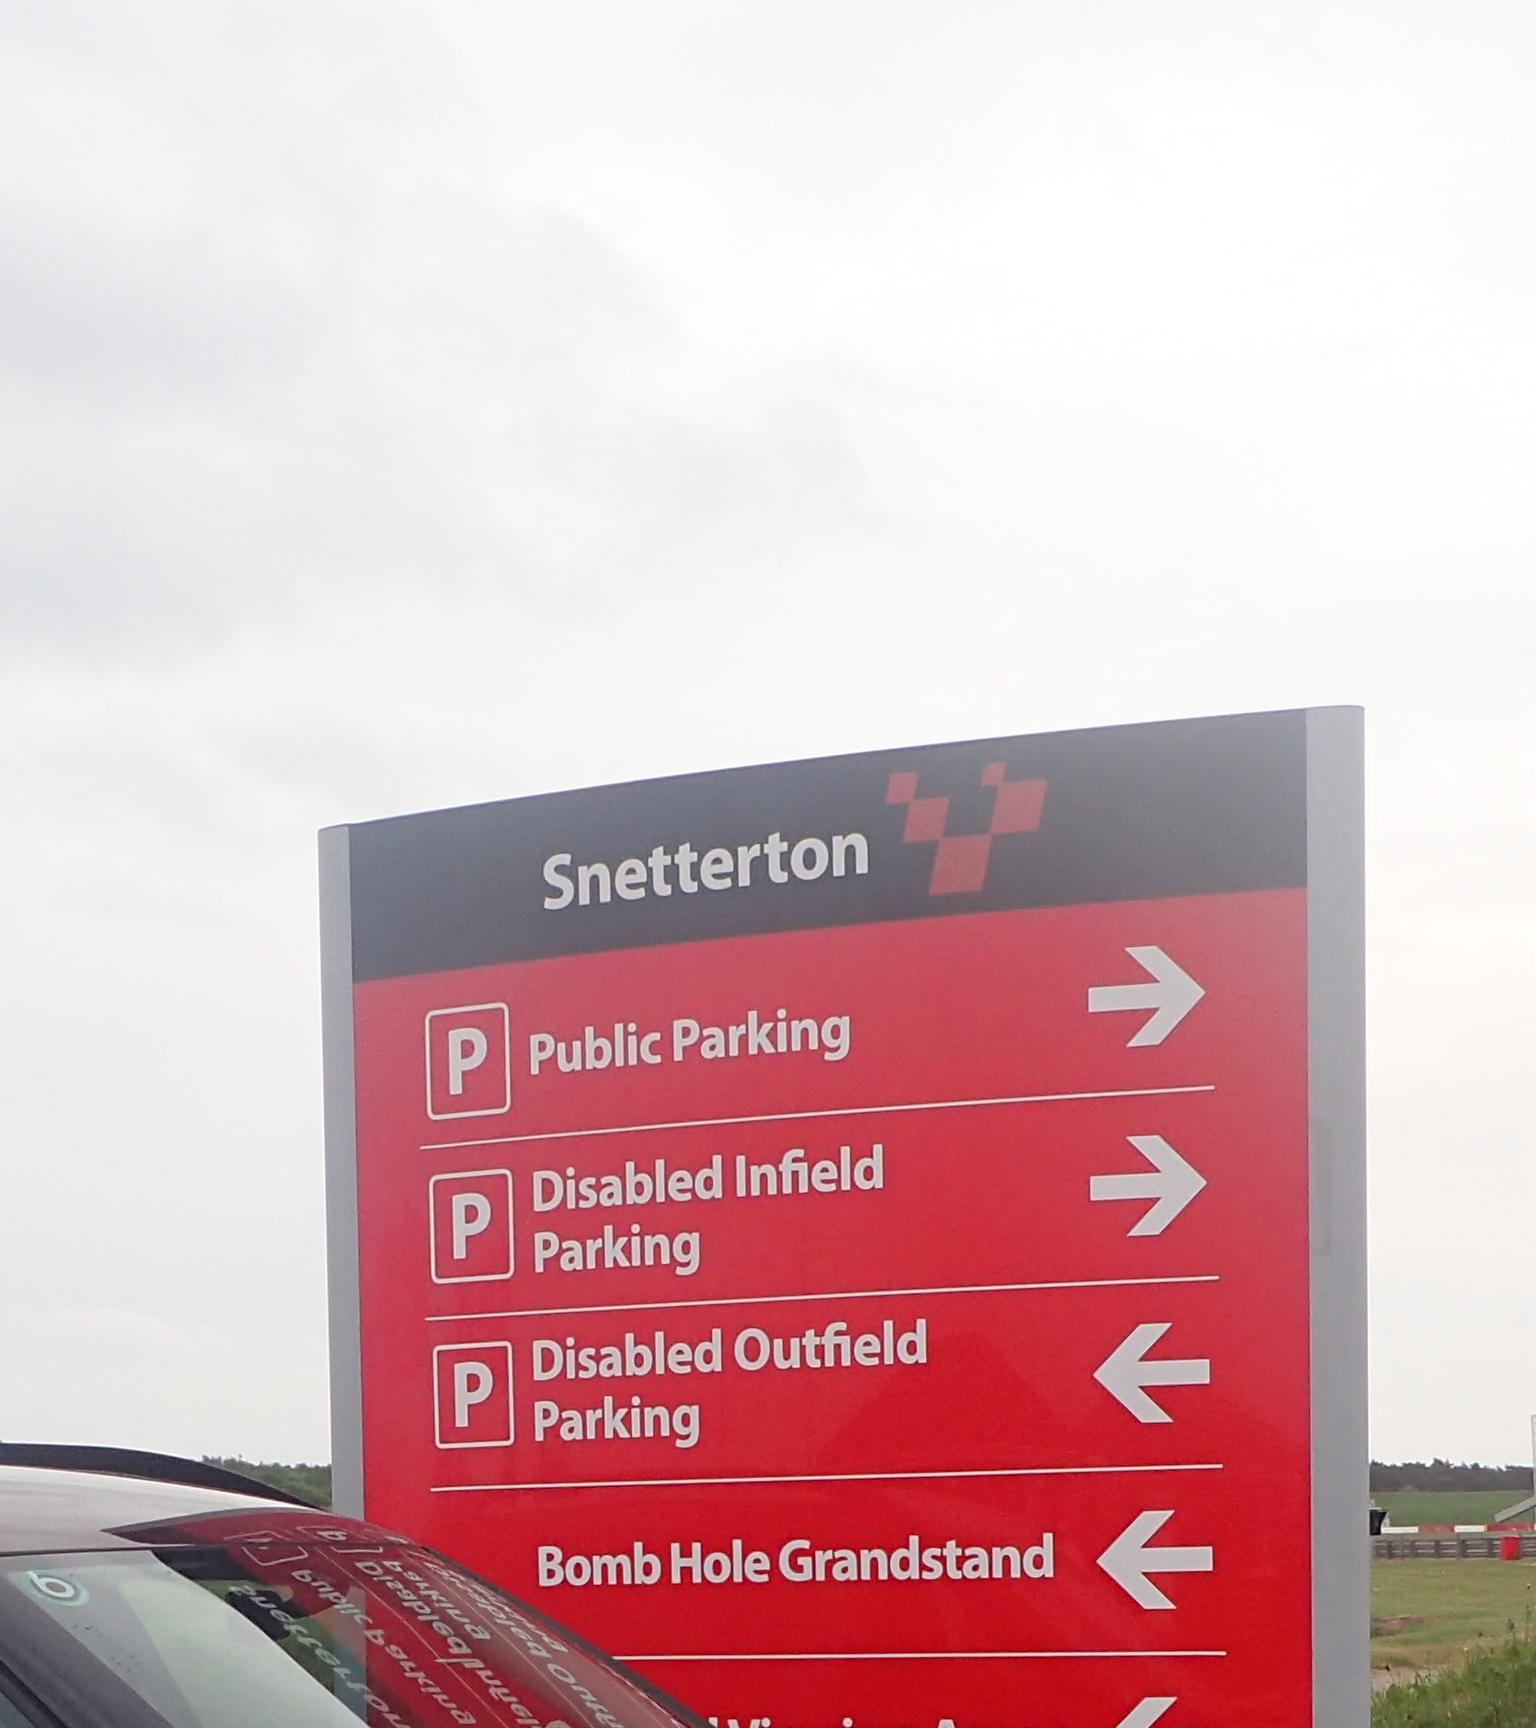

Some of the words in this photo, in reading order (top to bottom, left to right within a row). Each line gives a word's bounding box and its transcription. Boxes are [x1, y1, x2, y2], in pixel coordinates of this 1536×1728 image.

[544, 832, 868, 909] Snetterton
[449, 1028, 487, 1095] P
[530, 1023, 661, 1075] Public
[673, 1009, 849, 1061] Parking
[452, 1193, 491, 1259] P
[533, 1155, 722, 1211] Disabled
[736, 1144, 883, 1197] Infield
[535, 1224, 699, 1275] Parking
[454, 1362, 493, 1427] P
[533, 1329, 722, 1380] Disabled
[735, 1319, 926, 1370] Outfield
[535, 1396, 699, 1448] Parking
[538, 1542, 661, 1586] Bomb
[671, 1539, 770, 1583] Hole
[779, 1533, 1053, 1581] Grandstand
